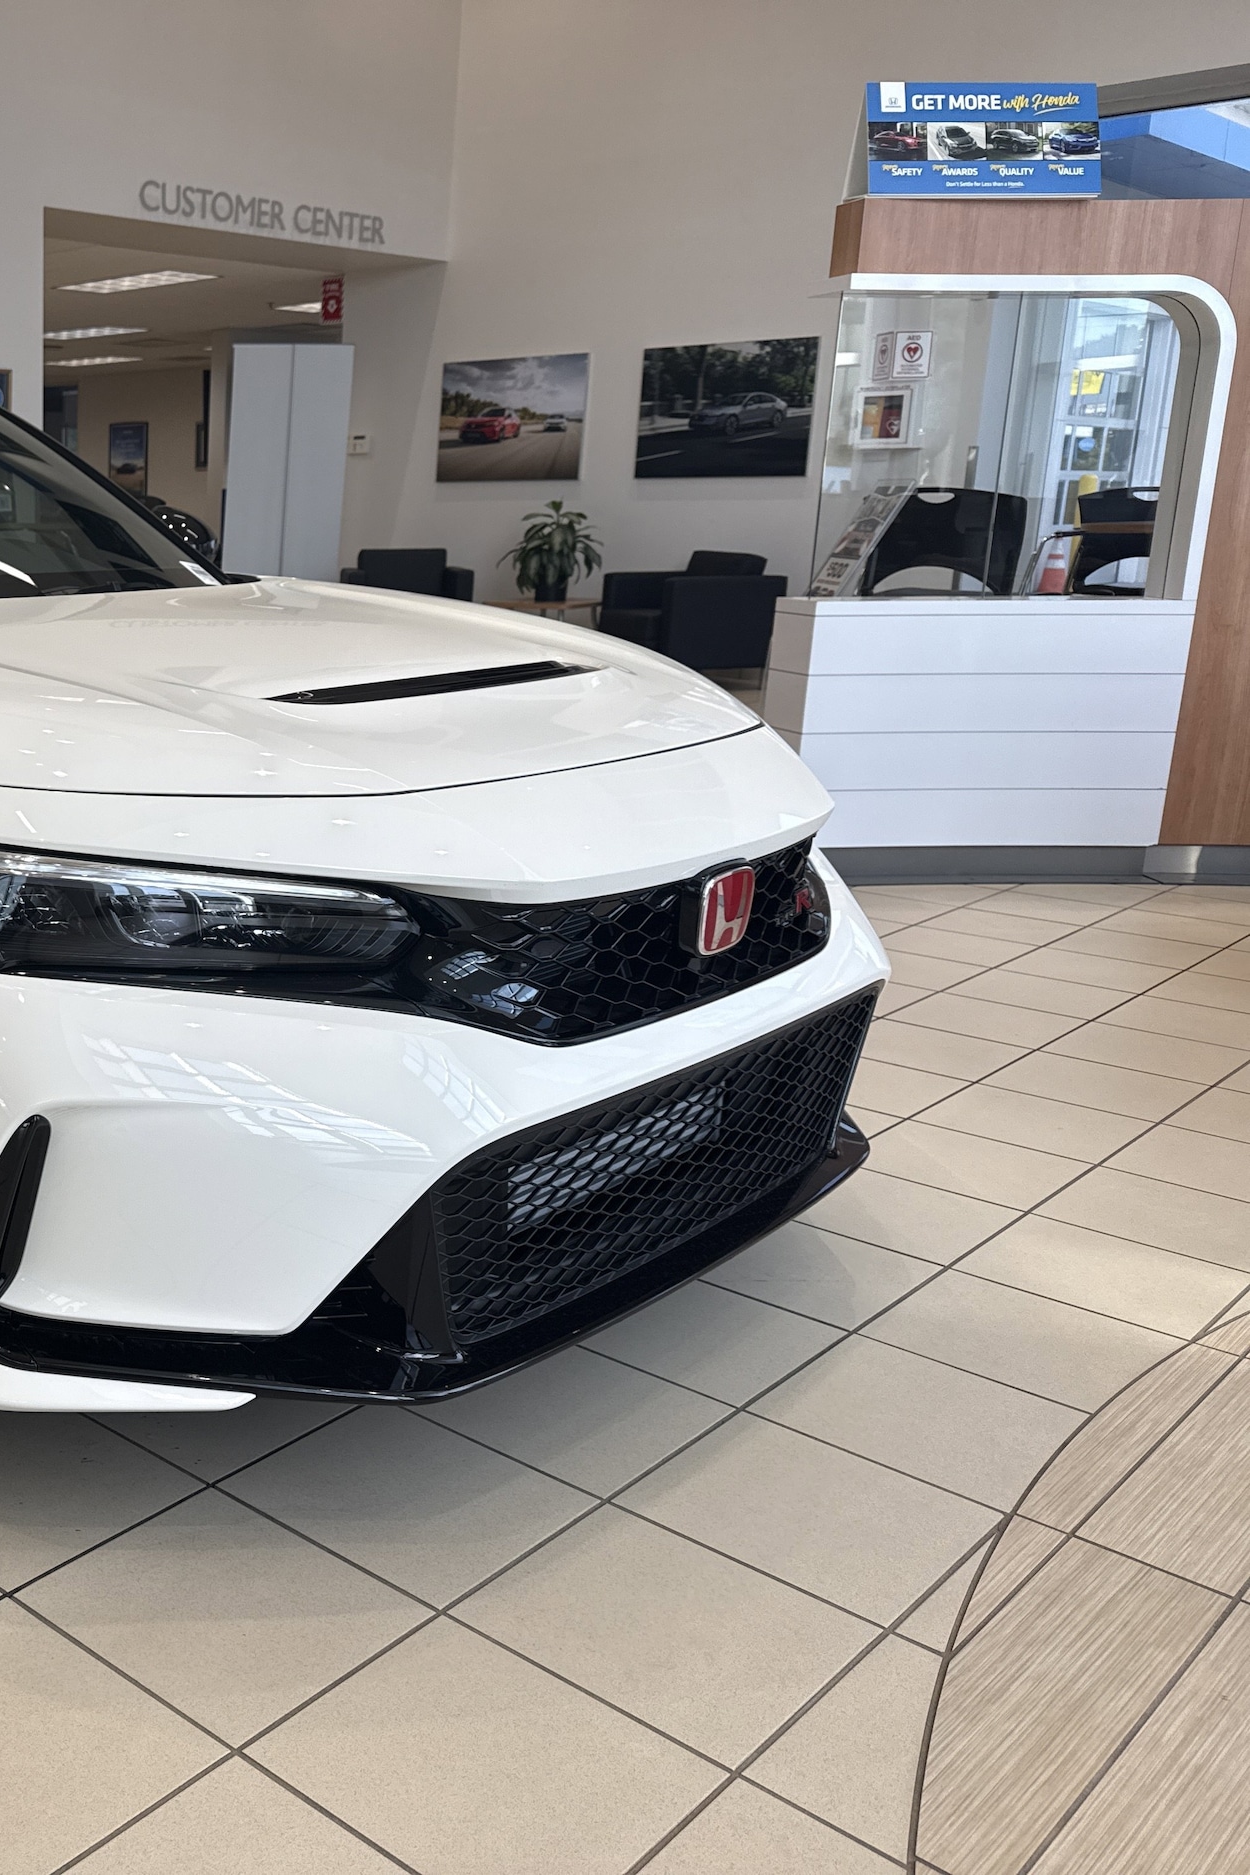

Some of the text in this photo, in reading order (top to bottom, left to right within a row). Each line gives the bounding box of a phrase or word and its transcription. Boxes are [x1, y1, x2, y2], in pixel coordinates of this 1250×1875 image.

[911, 92, 1081, 113] GET MORE with Honda
[891, 167, 923, 176] SAFETY
[941, 167, 979, 176] AWARDS
[999, 167, 1035, 177] QUALITY
[1057, 167, 1085, 176] VALUE
[138, 179, 386, 246] CUSTOMER CENTER
